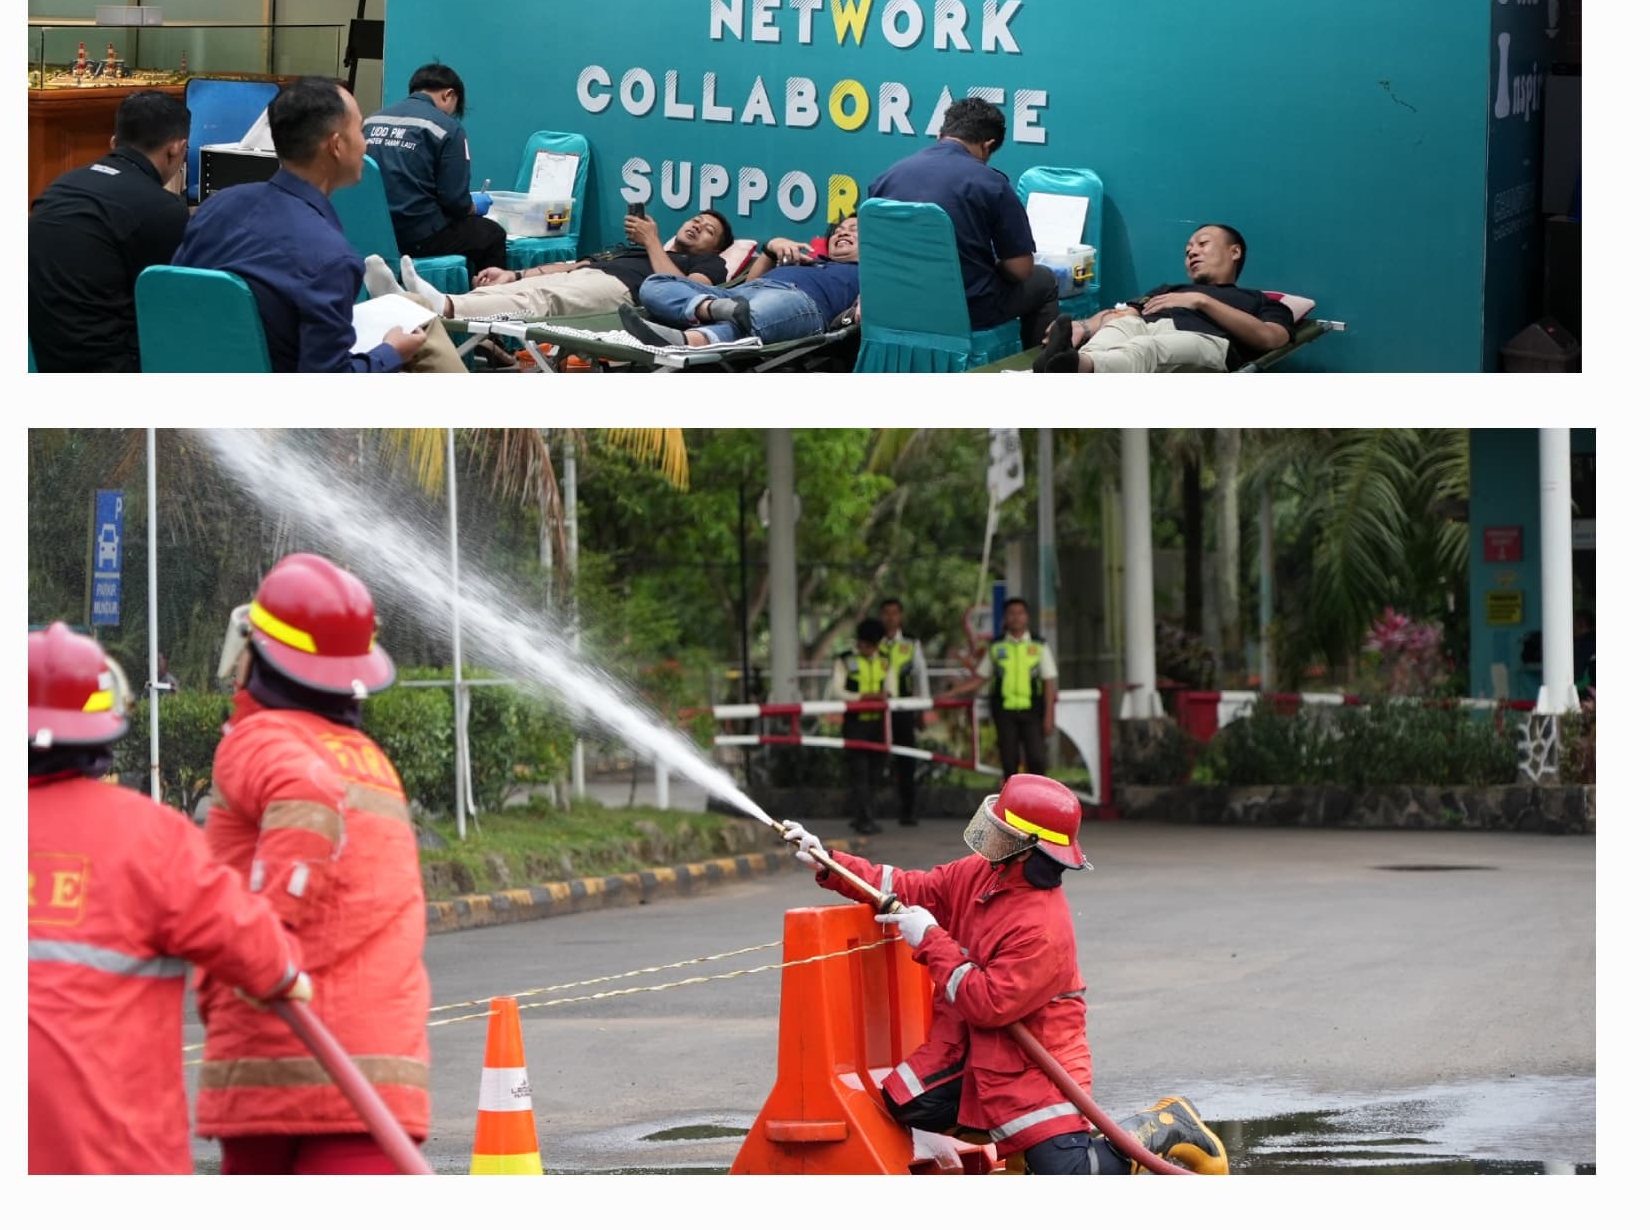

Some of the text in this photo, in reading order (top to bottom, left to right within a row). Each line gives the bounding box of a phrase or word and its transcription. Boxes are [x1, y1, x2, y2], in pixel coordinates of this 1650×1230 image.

[400, 140, 416, 150] LAUT
[620, 156, 860, 224] SUPPOR
[115, 497, 123, 521] P
